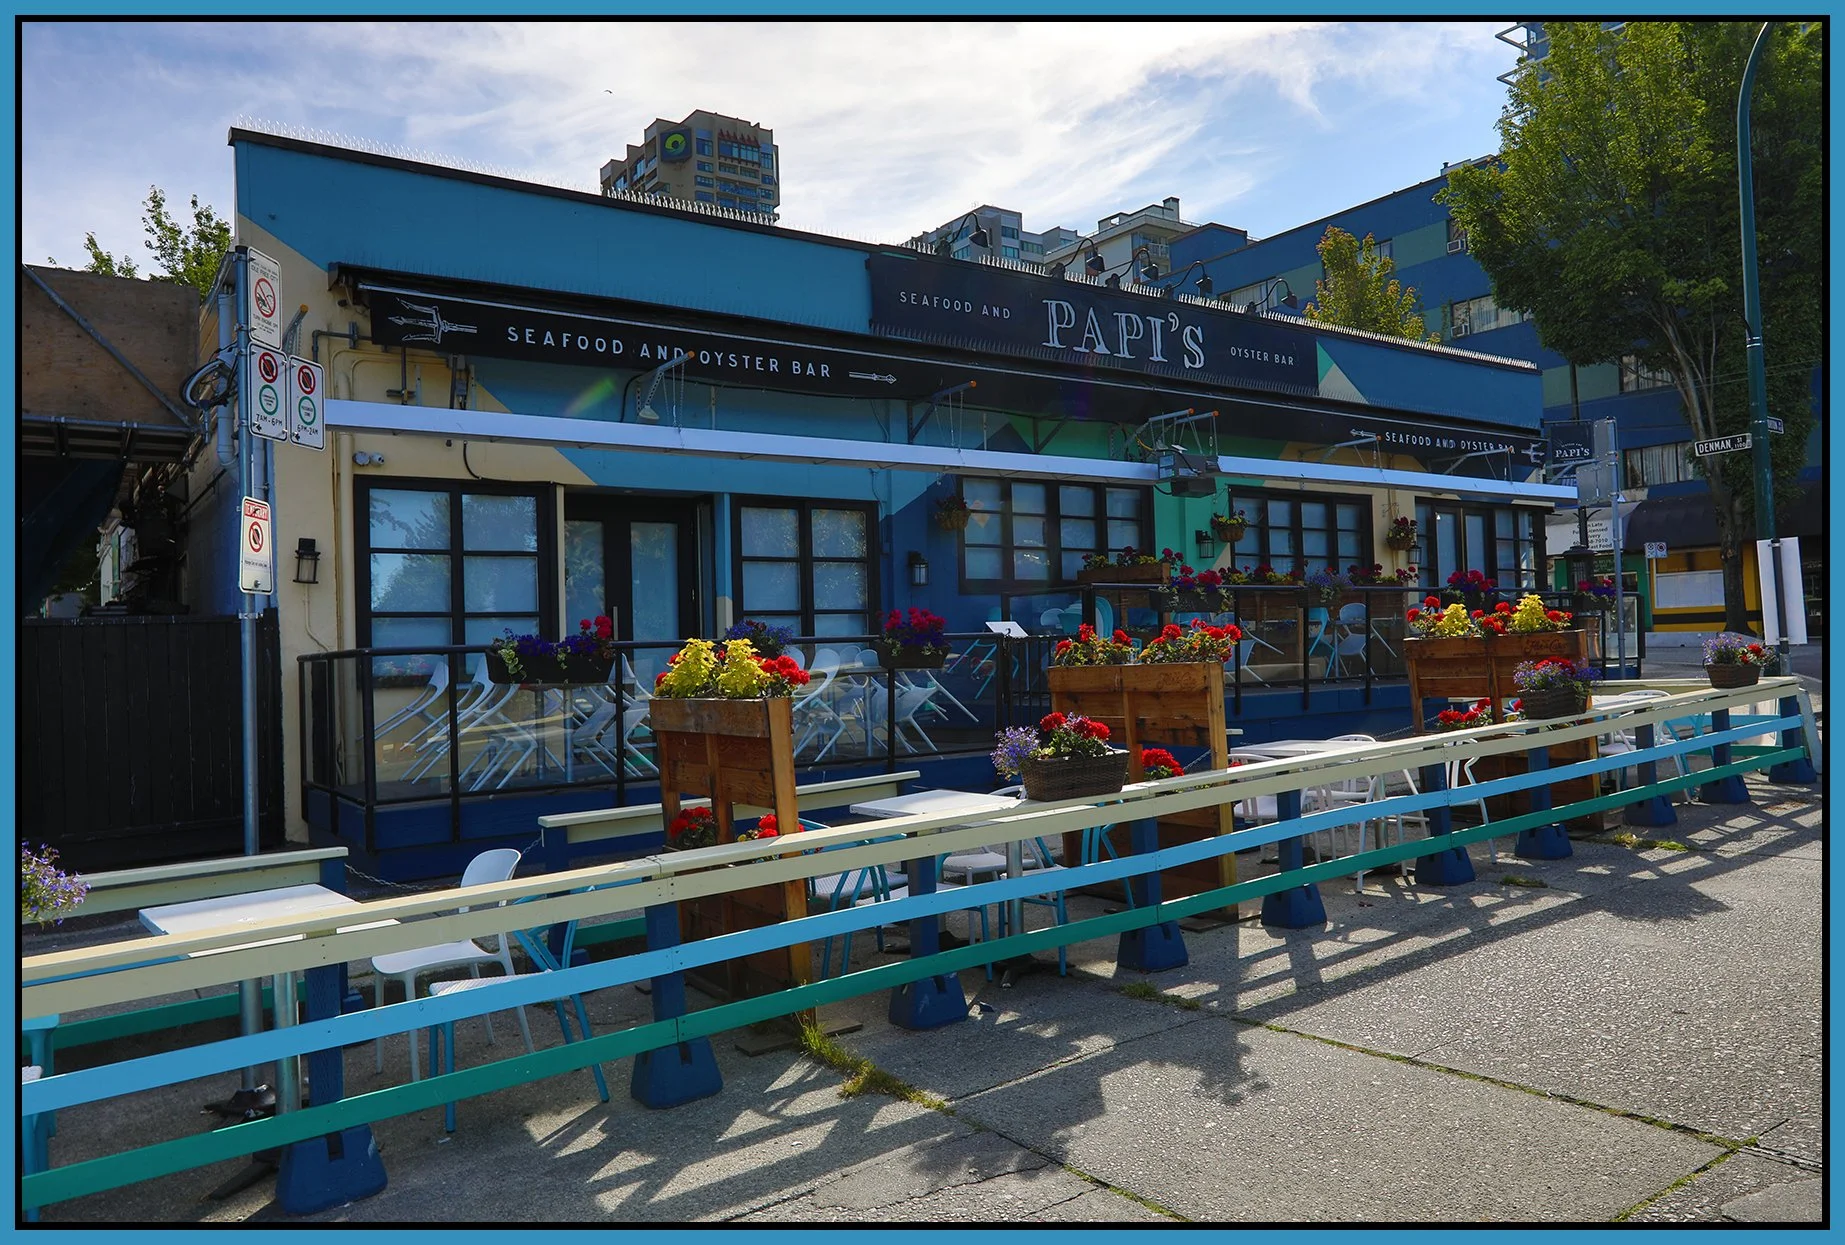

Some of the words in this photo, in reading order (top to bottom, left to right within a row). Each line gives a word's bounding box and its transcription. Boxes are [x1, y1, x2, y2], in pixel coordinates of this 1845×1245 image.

[899, 291, 972, 313] SEAFOOD
[981, 304, 1011, 319] AND
[1042, 299, 1205, 369] PAPI'S
[507, 326, 624, 355] SEAFOOD
[640, 343, 684, 360] AND
[699, 350, 780, 373] OYSTER
[792, 360, 831, 378] BAR
[1230, 346, 1269, 362] OYSTER
[1274, 354, 1295, 366] BAR
[1385, 431, 1431, 447] SEAFOOD
[1435, 437, 1456, 449] AND
[1460, 440, 1495, 452] OYSTER
[1698, 439, 1731, 454] DENMAN
[1555, 447, 1590, 458] PAPI'S
